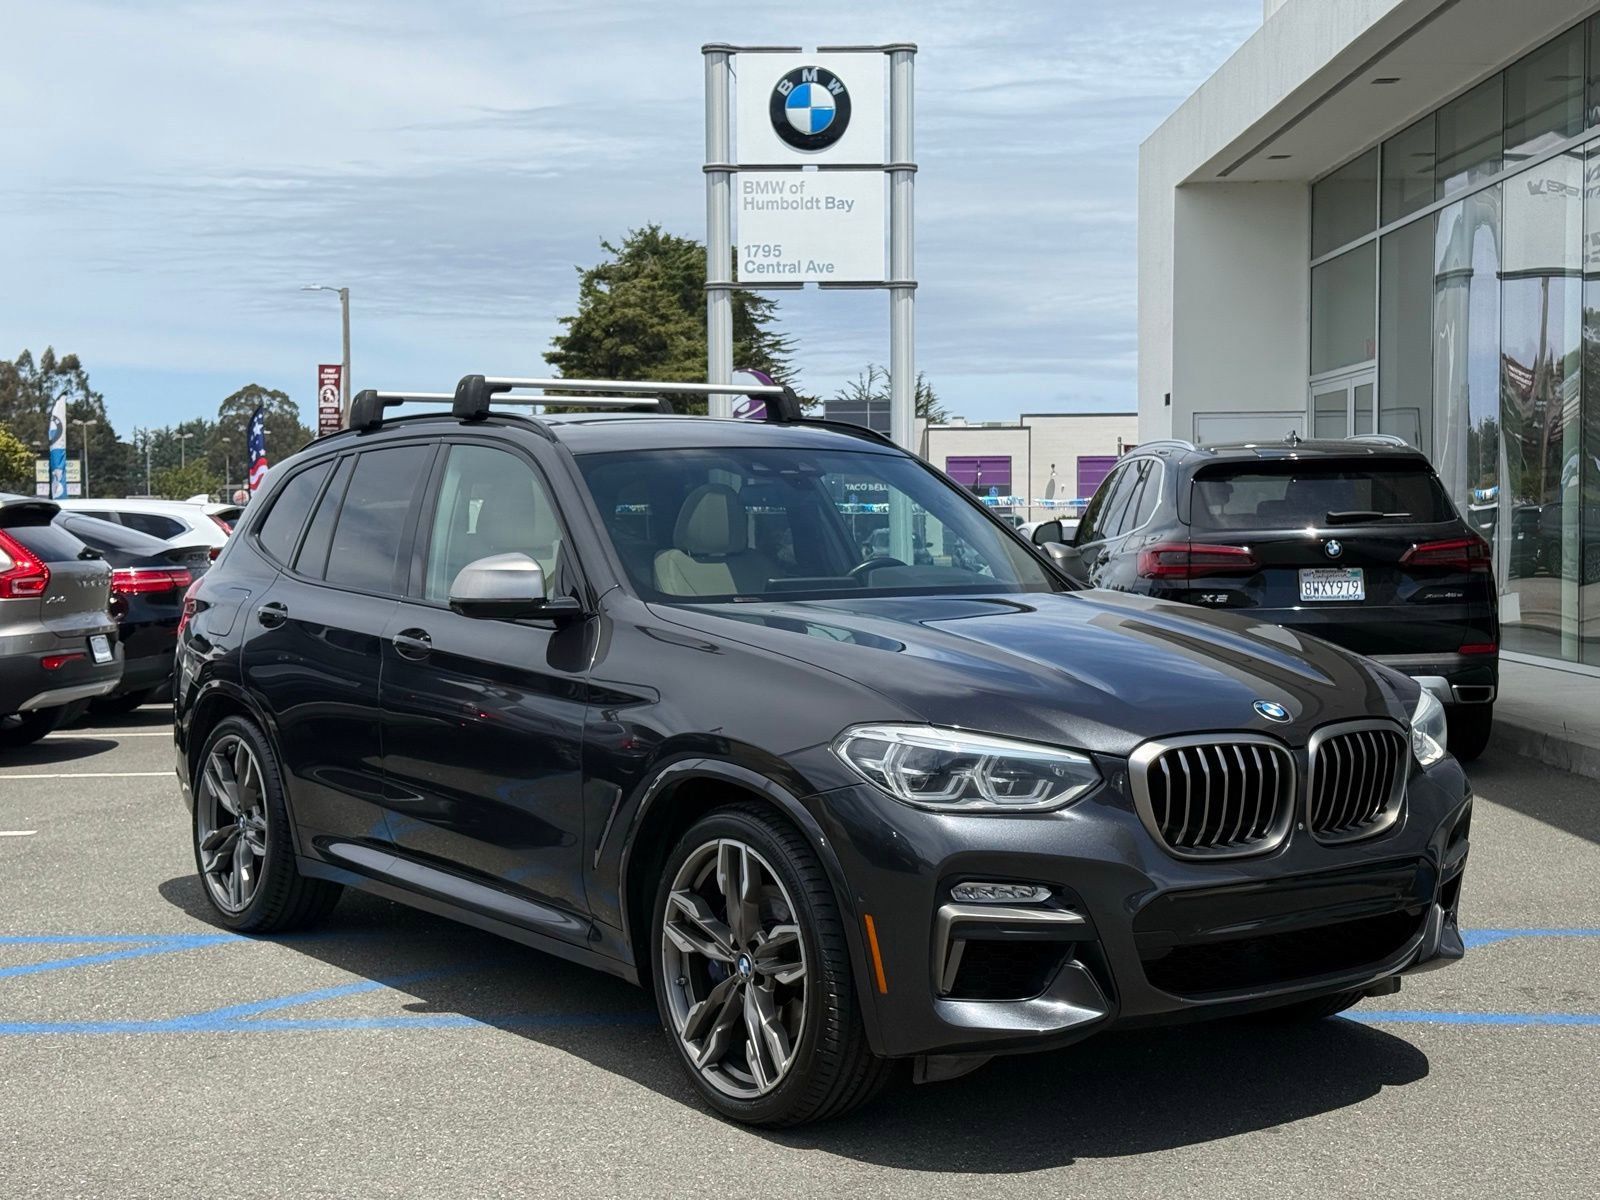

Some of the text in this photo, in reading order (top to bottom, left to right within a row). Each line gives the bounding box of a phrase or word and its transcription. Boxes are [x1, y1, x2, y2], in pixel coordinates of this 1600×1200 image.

[777, 68, 844, 97] BMW
[743, 180, 806, 194] BMW of
[743, 197, 854, 213] Humboldt Bay
[744, 244, 782, 257] 1795
[744, 260, 835, 274] Central Ave
[845, 483, 888, 491] TACO BELL
[1304, 580, 1359, 595] 8WXY979
